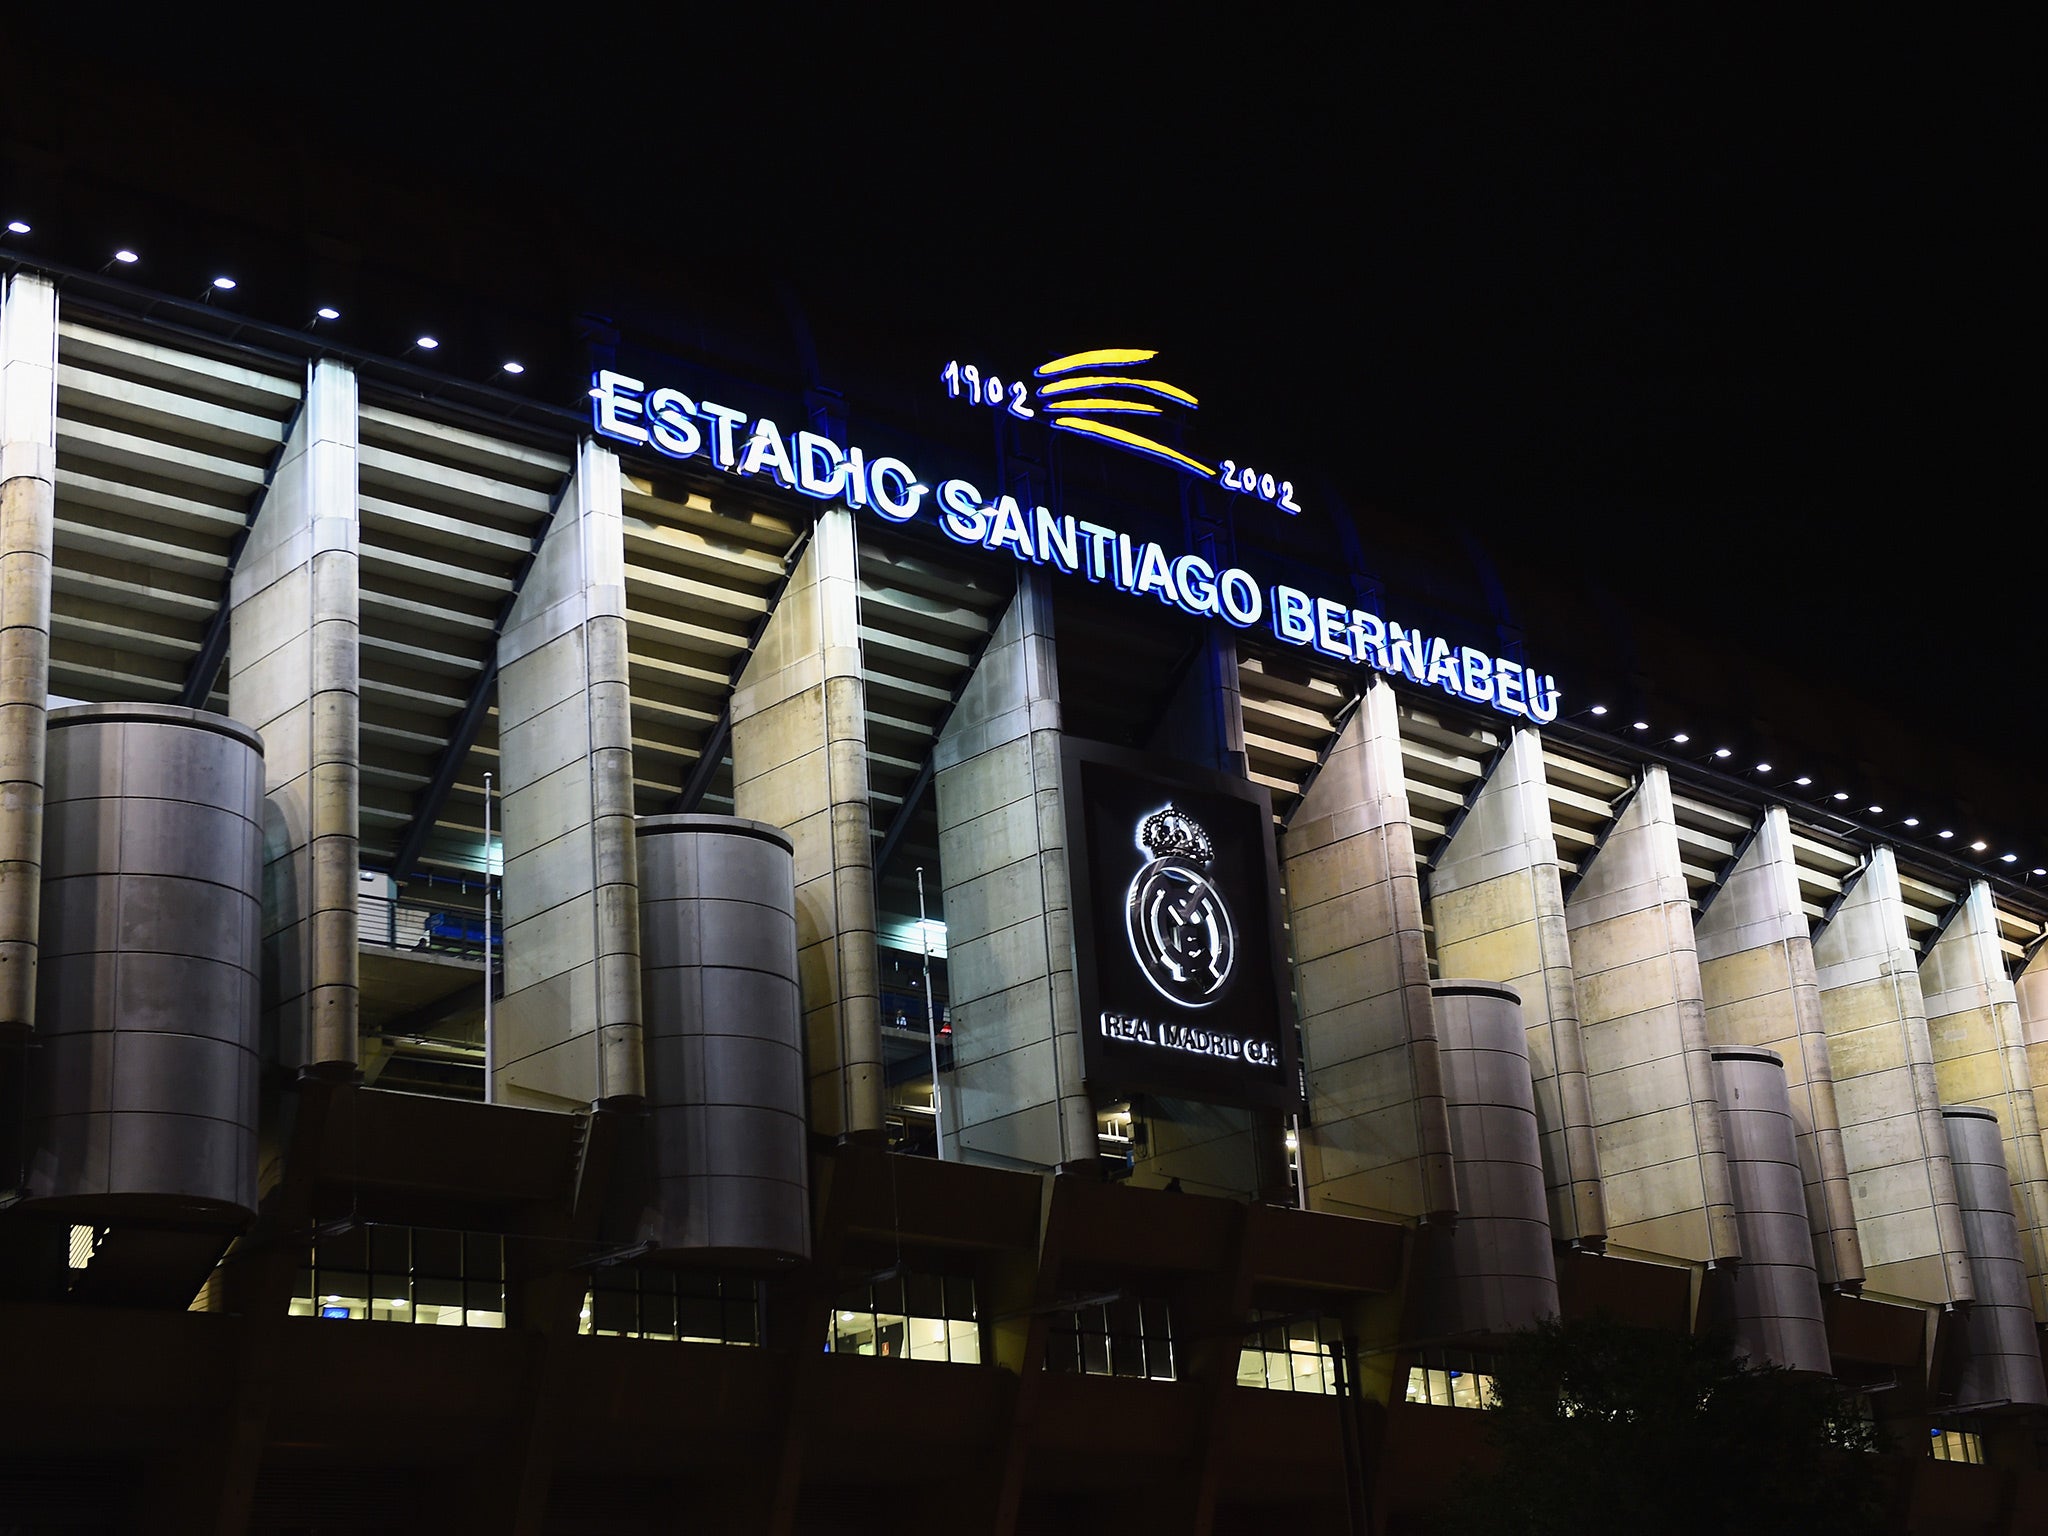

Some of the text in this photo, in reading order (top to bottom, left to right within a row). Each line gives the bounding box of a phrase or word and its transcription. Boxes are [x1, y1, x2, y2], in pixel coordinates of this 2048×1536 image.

[942, 360, 1034, 418] 1902
[1220, 460, 1301, 514] 2002
[592, 369, 1559, 723] ESTADIO SANTIAGO BERNABEU
[1100, 1012, 1157, 1044] REAL
[1159, 1023, 1242, 1059] MADRID
